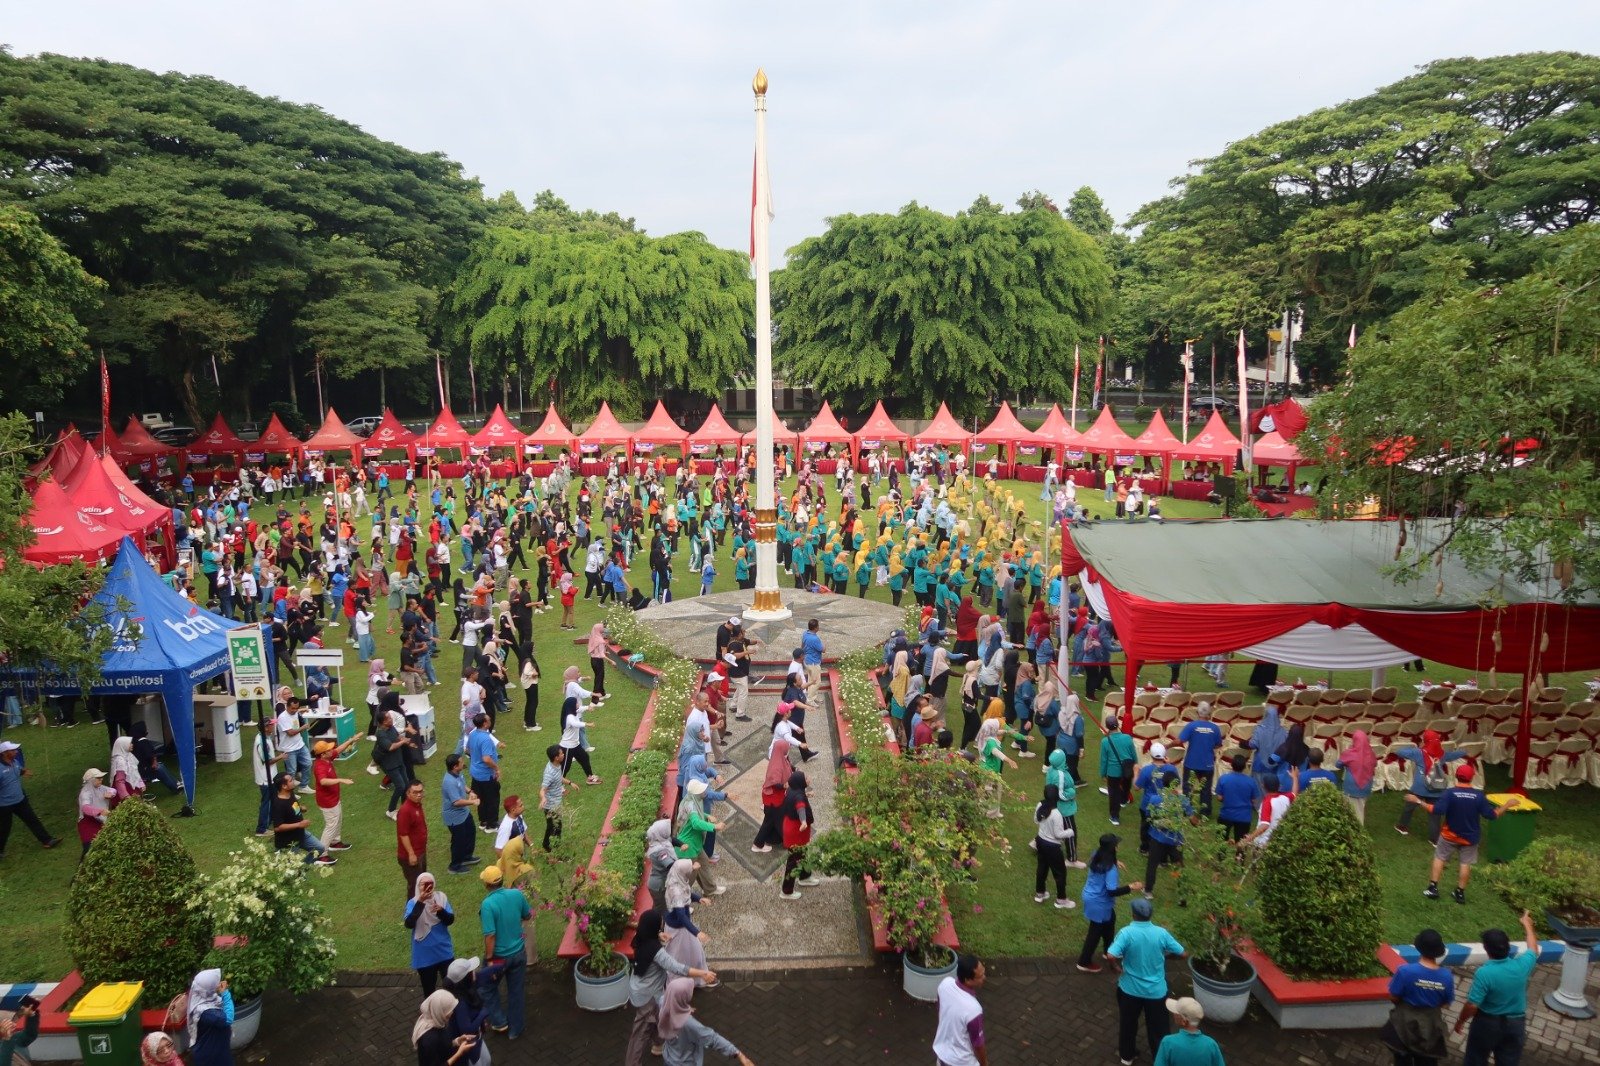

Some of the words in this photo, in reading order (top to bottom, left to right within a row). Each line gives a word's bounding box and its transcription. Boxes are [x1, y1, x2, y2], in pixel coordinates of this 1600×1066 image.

[163, 615, 220, 641] btn
[190, 659, 218, 679] download
[116, 674, 164, 689] aplikasi
